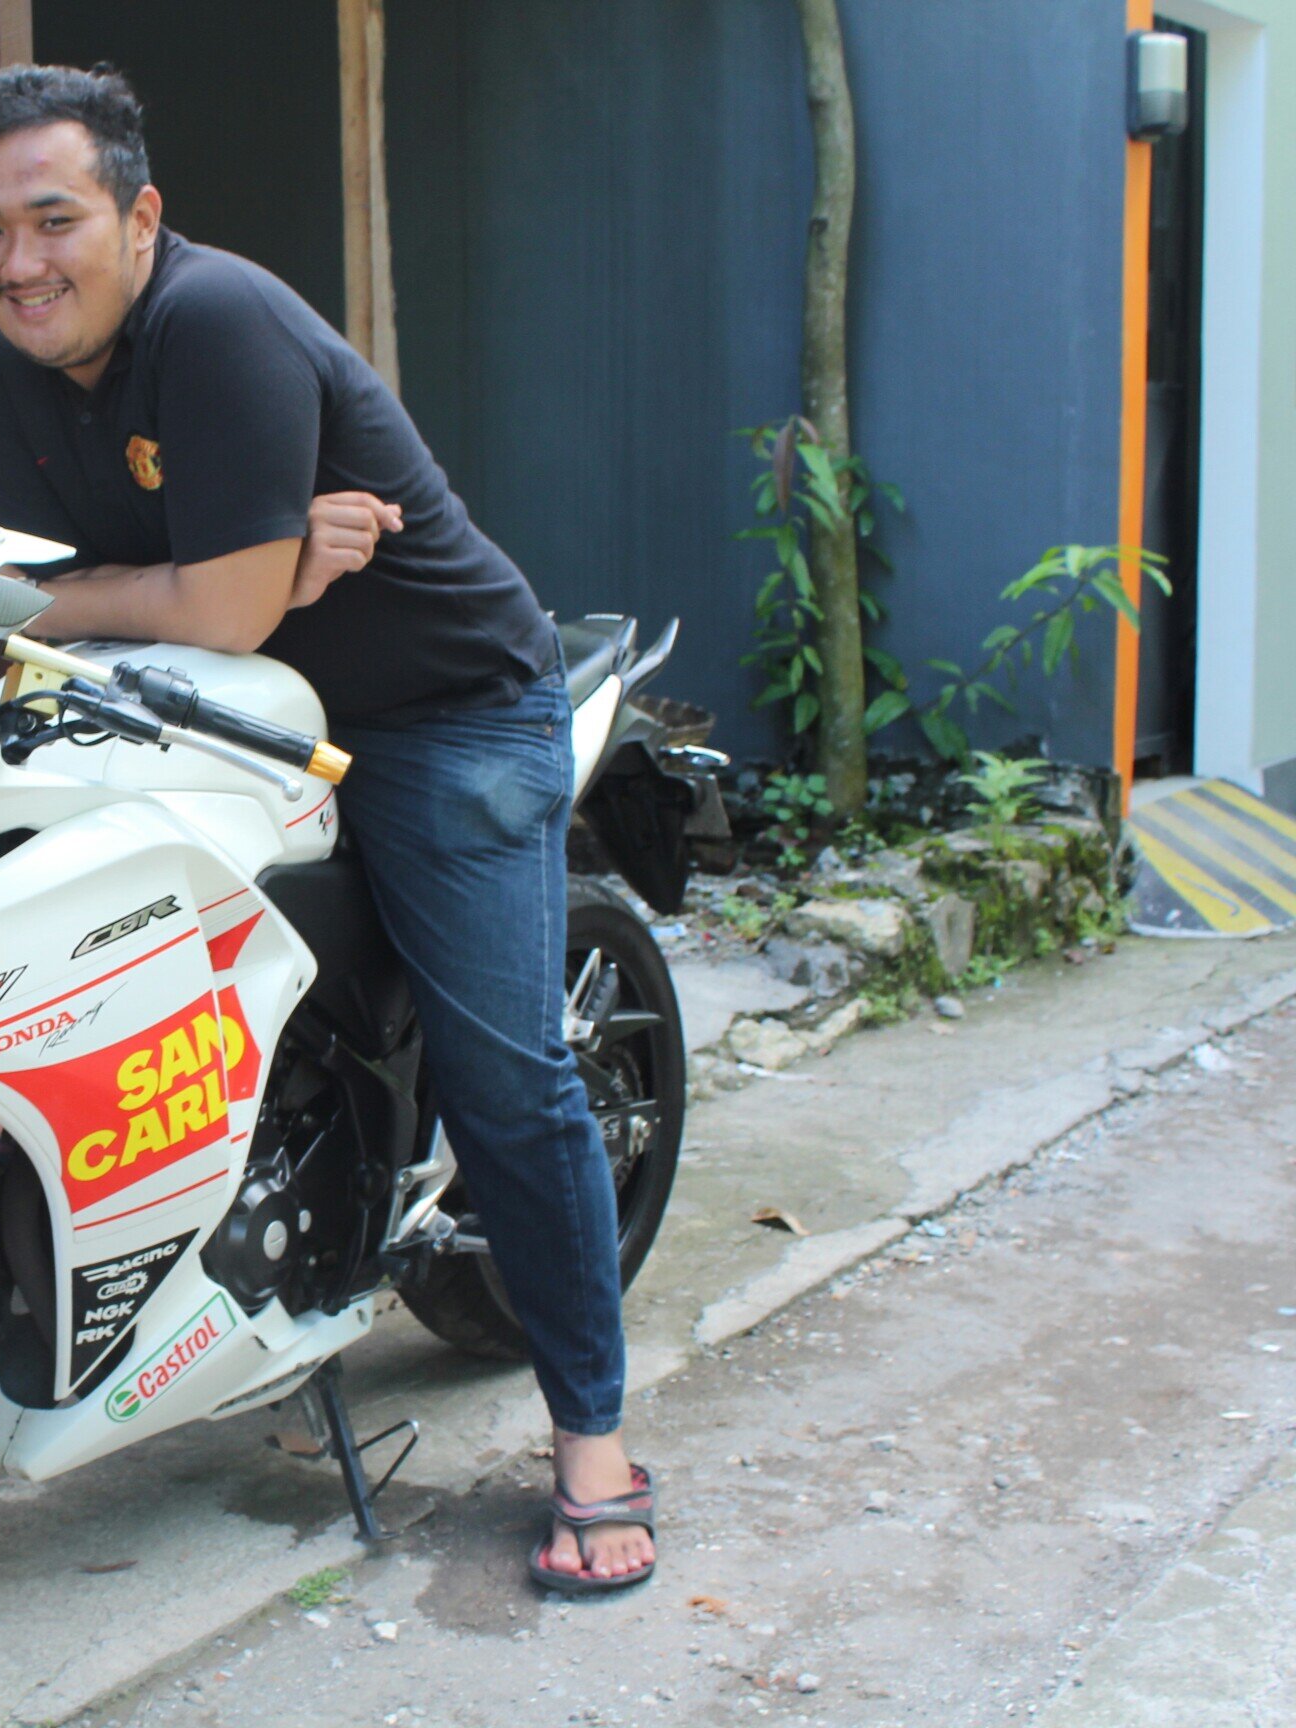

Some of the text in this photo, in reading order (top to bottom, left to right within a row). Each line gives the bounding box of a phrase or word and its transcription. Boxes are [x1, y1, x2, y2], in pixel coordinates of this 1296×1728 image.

[70, 894, 184, 961] CBR
[75, 1322, 117, 1346] RK
[84, 1300, 136, 1325] NGK
[137, 1315, 220, 1400] Castrol
